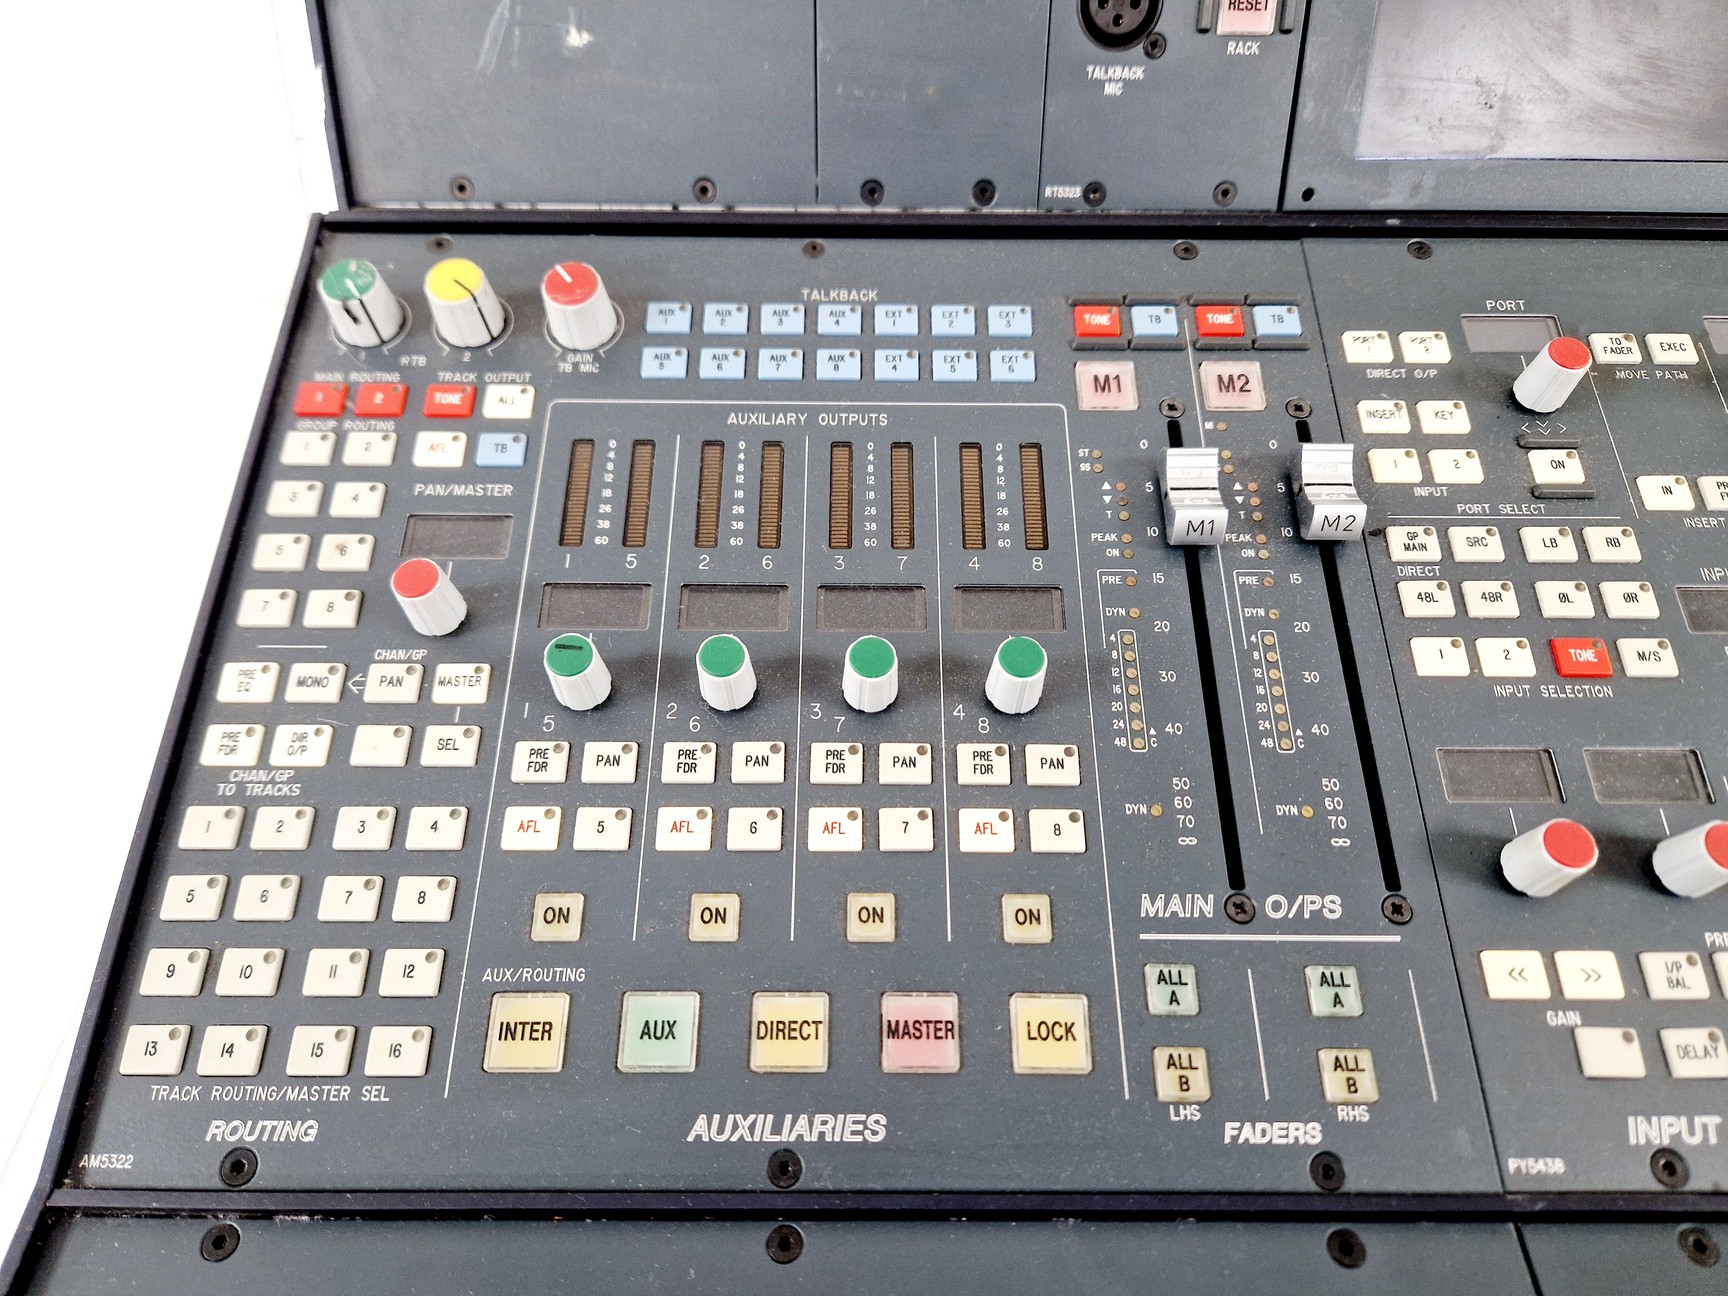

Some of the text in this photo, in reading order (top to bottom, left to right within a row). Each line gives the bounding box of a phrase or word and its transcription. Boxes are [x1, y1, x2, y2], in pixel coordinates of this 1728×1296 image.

[1226, 41, 1260, 55] RACK
[1087, 65, 1144, 80] TALKBACK
[1104, 82, 1124, 96] MIC
[801, 289, 878, 301] TALKBACK
[1486, 300, 1525, 311] PORT
[1084, 314, 1111, 325] TONE
[1149, 315, 1161, 324] TB
[1207, 313, 1233, 325] TONE
[1609, 337, 1621, 346] TO
[1660, 342, 1687, 351] EXEC
[1603, 347, 1633, 355] FADER
[401, 355, 426, 366] RTB
[567, 353, 593, 363] GAIN
[654, 353, 671, 361] AUX
[712, 354, 729, 362] AUX
[770, 354, 787, 363] AUX
[828, 355, 845, 363] AUX
[885, 355, 902, 363] EXT
[944, 356, 961, 364] EXT
[1002, 356, 1019, 364] EXT
[558, 363, 599, 373] TB MIC
[1366, 369, 1437, 378] DIRECT O/P
[350, 372, 400, 382] ROUTING
[438, 373, 531, 383] TRACK OUTPUT
[1616, 370, 1687, 379] MOVE PATH
[1094, 374, 1121, 393] M1
[1217, 373, 1251, 393] M2
[434, 393, 462, 404] TONE
[498, 397, 517, 405] ALL
[727, 413, 888, 426] AUXILIARY OUTPUTS
[1366, 410, 1401, 419] INSERT
[1434, 410, 1453, 420] KEY
[345, 421, 395, 431] ROUTING
[428, 443, 446, 453] AFL
[494, 443, 507, 454] TB
[1078, 448, 1089, 457] ST
[1080, 463, 1091, 471] SS
[1550, 459, 1565, 470] ON
[413, 484, 514, 497] PAN/MASTER
[1414, 486, 1448, 496] INPUT
[1661, 486, 1673, 495] IN
[1457, 504, 1546, 514] PORT SELECT
[1186, 519, 1214, 536] M1
[1321, 515, 1356, 532] M2
[1683, 518, 1726, 528] INSERT
[1147, 526, 1159, 537] 10
[1407, 532, 1418, 541] GP
[1091, 533, 1117, 542] PEAK
[1466, 537, 1488, 547] SRC
[1542, 537, 1558, 548] LB
[1606, 537, 1621, 548] RB
[1106, 548, 1119, 557] ON
[1404, 543, 1427, 552] MAIN
[1397, 566, 1440, 577] DIRECT
[1102, 575, 1121, 585] PRE
[1153, 573, 1164, 584] 15
[1417, 592, 1439, 603] 48L
[1481, 592, 1503, 603] 48R
[1106, 607, 1125, 618] DYN
[1154, 621, 1170, 632] 20
[375, 650, 427, 661] CHAN/GP
[1569, 650, 1597, 662] TONE
[1637, 651, 1661, 662] M/S
[238, 670, 256, 680] PRE
[1159, 670, 1176, 682] 30
[237, 682, 250, 692] EQ
[297, 676, 329, 688] MONO
[379, 676, 404, 687] PAN
[438, 676, 482, 687] MASTER
[1494, 686, 1613, 698] INPUT SELECTION
[1165, 723, 1183, 734] 40
[221, 732, 241, 742] PRE
[291, 732, 308, 743] DIR
[218, 745, 238, 755] FDR
[437, 739, 459, 750] SEL
[287, 745, 307, 756] O/P
[529, 749, 549, 759] PRE
[678, 750, 698, 760] PRE
[825, 750, 846, 760] PRE
[596, 755, 620, 766] PAN
[745, 756, 769, 767] PAN
[892, 756, 917, 768] PAN
[972, 751, 993, 762] PRE
[527, 762, 548, 772] FDR
[676, 763, 697, 773] FDR
[825, 764, 846, 774] FDR
[1040, 757, 1065, 770] PAN
[973, 764, 994, 775] FDR
[230, 770, 294, 782] CHAN/GP
[1172, 777, 1190, 790] 50
[217, 784, 301, 796] TO TRACKS
[1174, 797, 1192, 809] 60
[1125, 804, 1147, 815] DYN
[517, 821, 541, 833] AFL
[670, 821, 694, 833] AFL
[1176, 815, 1195, 828] 70
[822, 822, 846, 835] AFL
[974, 823, 998, 835] AFL
[1140, 894, 1342, 919] MAIN O/PS
[543, 907, 570, 924] ON
[700, 907, 727, 924] ON
[858, 906, 884, 923] ON
[1015, 908, 1041, 925] ON
[239, 965, 253, 979] 10
[329, 965, 337, 979] 11
[402, 965, 415, 978] 12
[1664, 961, 1682, 974] I/P
[482, 968, 586, 982] AUX/ROUTING
[1157, 969, 1188, 986] ALL
[1320, 971, 1351, 988] ALL
[1666, 976, 1691, 989] BAL
[1169, 990, 1180, 1006] A
[1333, 992, 1344, 1008] A
[1546, 1011, 1581, 1026] GAIN
[498, 1021, 553, 1041] INTER
[640, 1020, 677, 1040] AUX
[757, 1021, 823, 1041] DIRECT
[887, 1020, 955, 1040] MASTER
[1027, 1021, 1077, 1041] LOCK
[144, 1041, 157, 1056] 13
[220, 1043, 234, 1058] 14
[311, 1042, 324, 1057] 15
[388, 1043, 402, 1057] 16
[1677, 1045, 1719, 1060] DELAY
[1167, 1053, 1198, 1070] ALL
[1333, 1055, 1366, 1072] ALL
[1179, 1076, 1190, 1092] B
[1346, 1077, 1358, 1094] B
[150, 1085, 389, 1102] TRACK ROUTING/MASTER SEL
[1169, 1105, 1201, 1121] LHS
[1337, 1106, 1370, 1122] RHS
[205, 1120, 319, 1142] ROUTING
[687, 1114, 887, 1142] AUXILIARIES
[1224, 1122, 1322, 1144] FADERS
[1627, 1115, 1723, 1146] INPUT
[78, 1154, 134, 1169] AM5322
